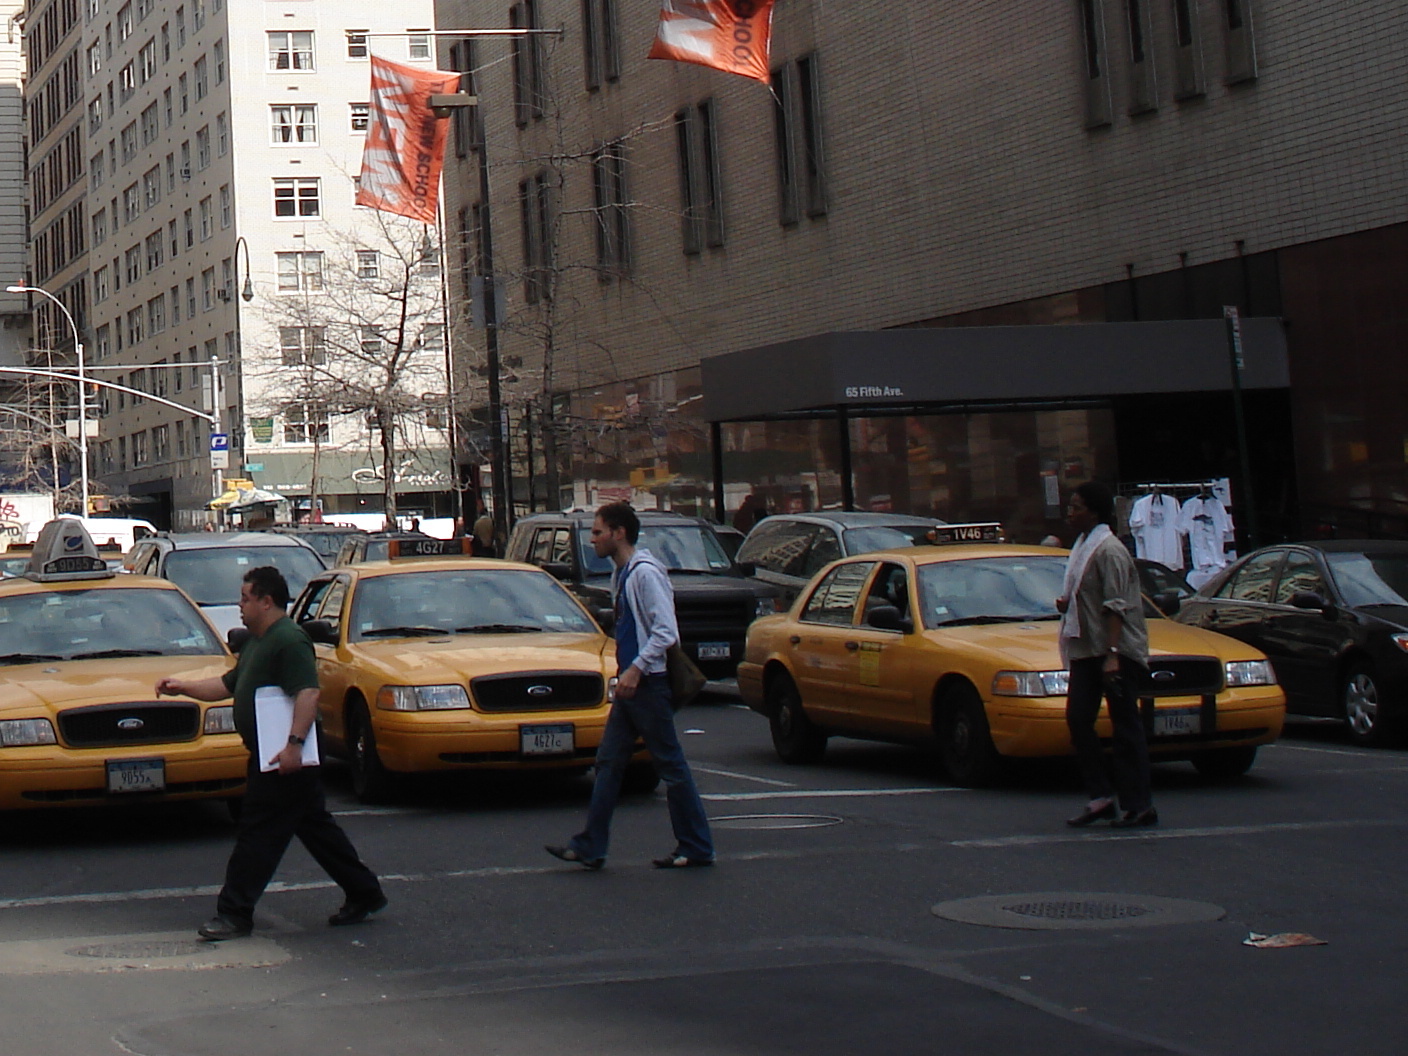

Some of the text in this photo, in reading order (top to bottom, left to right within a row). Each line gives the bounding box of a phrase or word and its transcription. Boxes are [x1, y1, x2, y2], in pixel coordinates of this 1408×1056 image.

[420, 116, 438, 150] NEW
[845, 386, 904, 398] 65 Fifth Ave.
[953, 527, 981, 540] 1V46
[416, 541, 444, 554] 4G27
